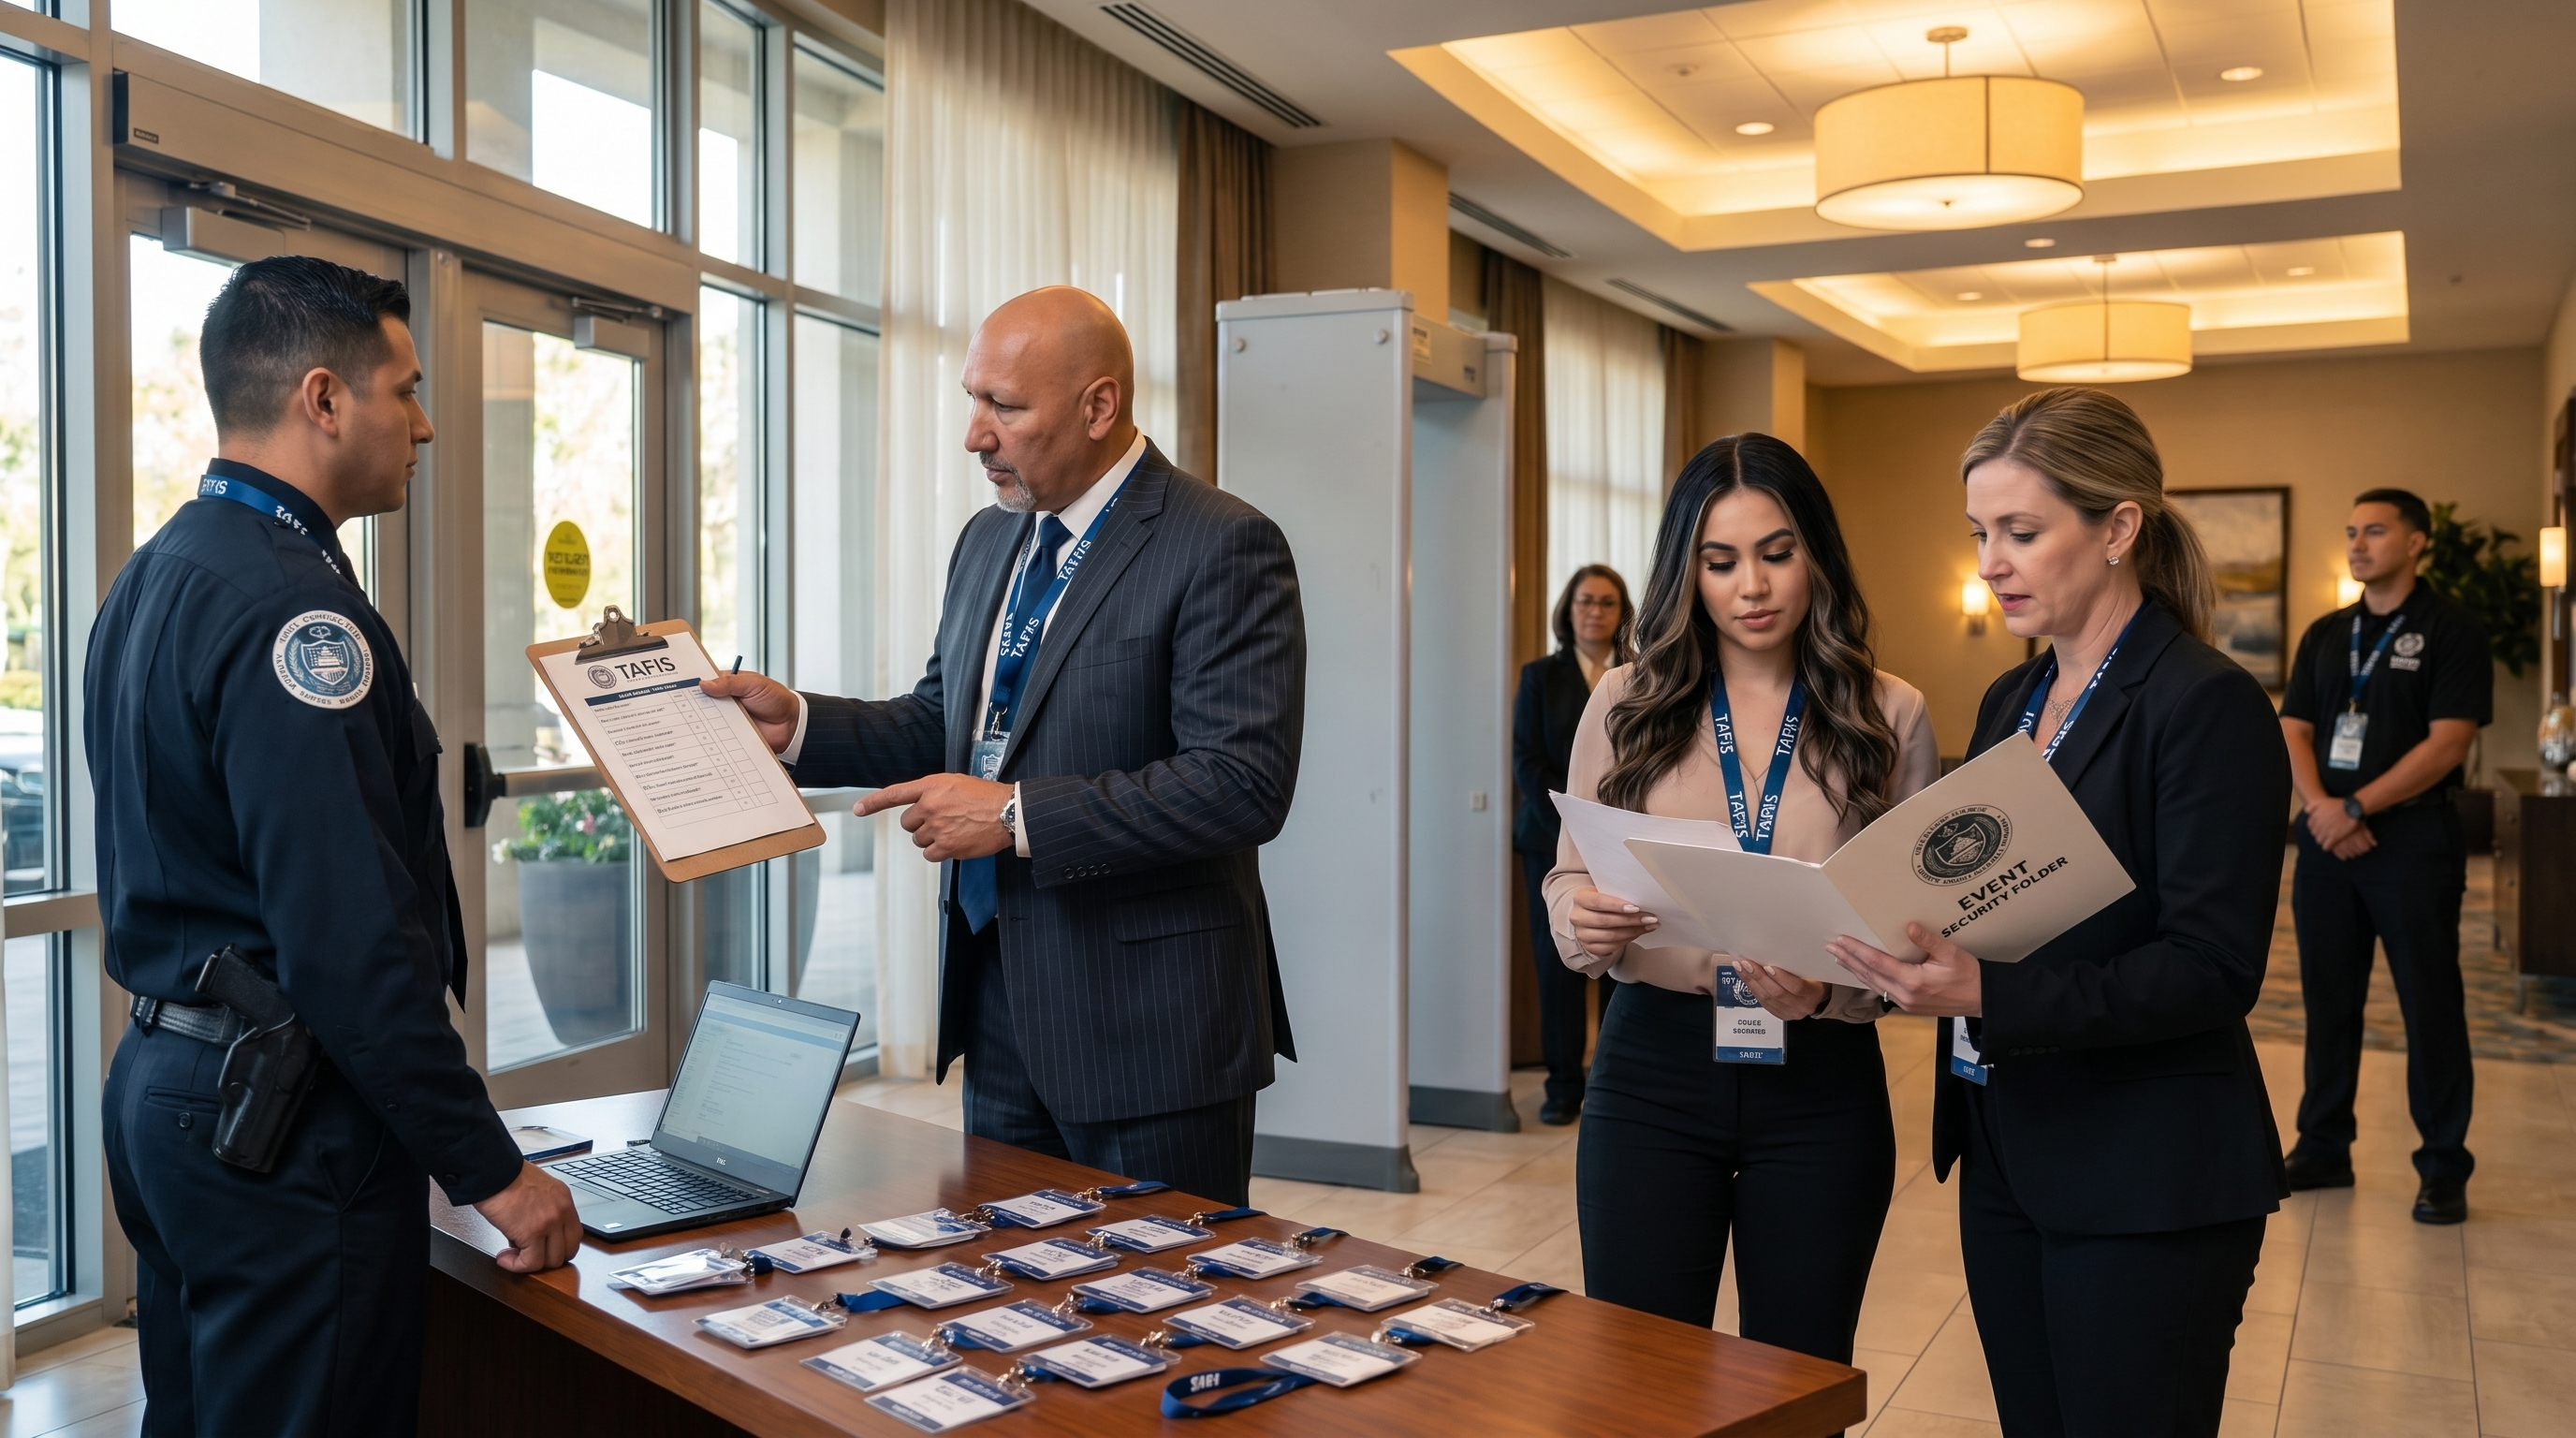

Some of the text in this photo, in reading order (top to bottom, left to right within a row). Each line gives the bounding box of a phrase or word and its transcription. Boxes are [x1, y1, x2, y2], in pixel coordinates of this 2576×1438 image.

[614, 657, 676, 680] TAFIS
[1940, 857, 2069, 938] SECURITY FOLDER
[1957, 859, 2028, 911] EVENT
